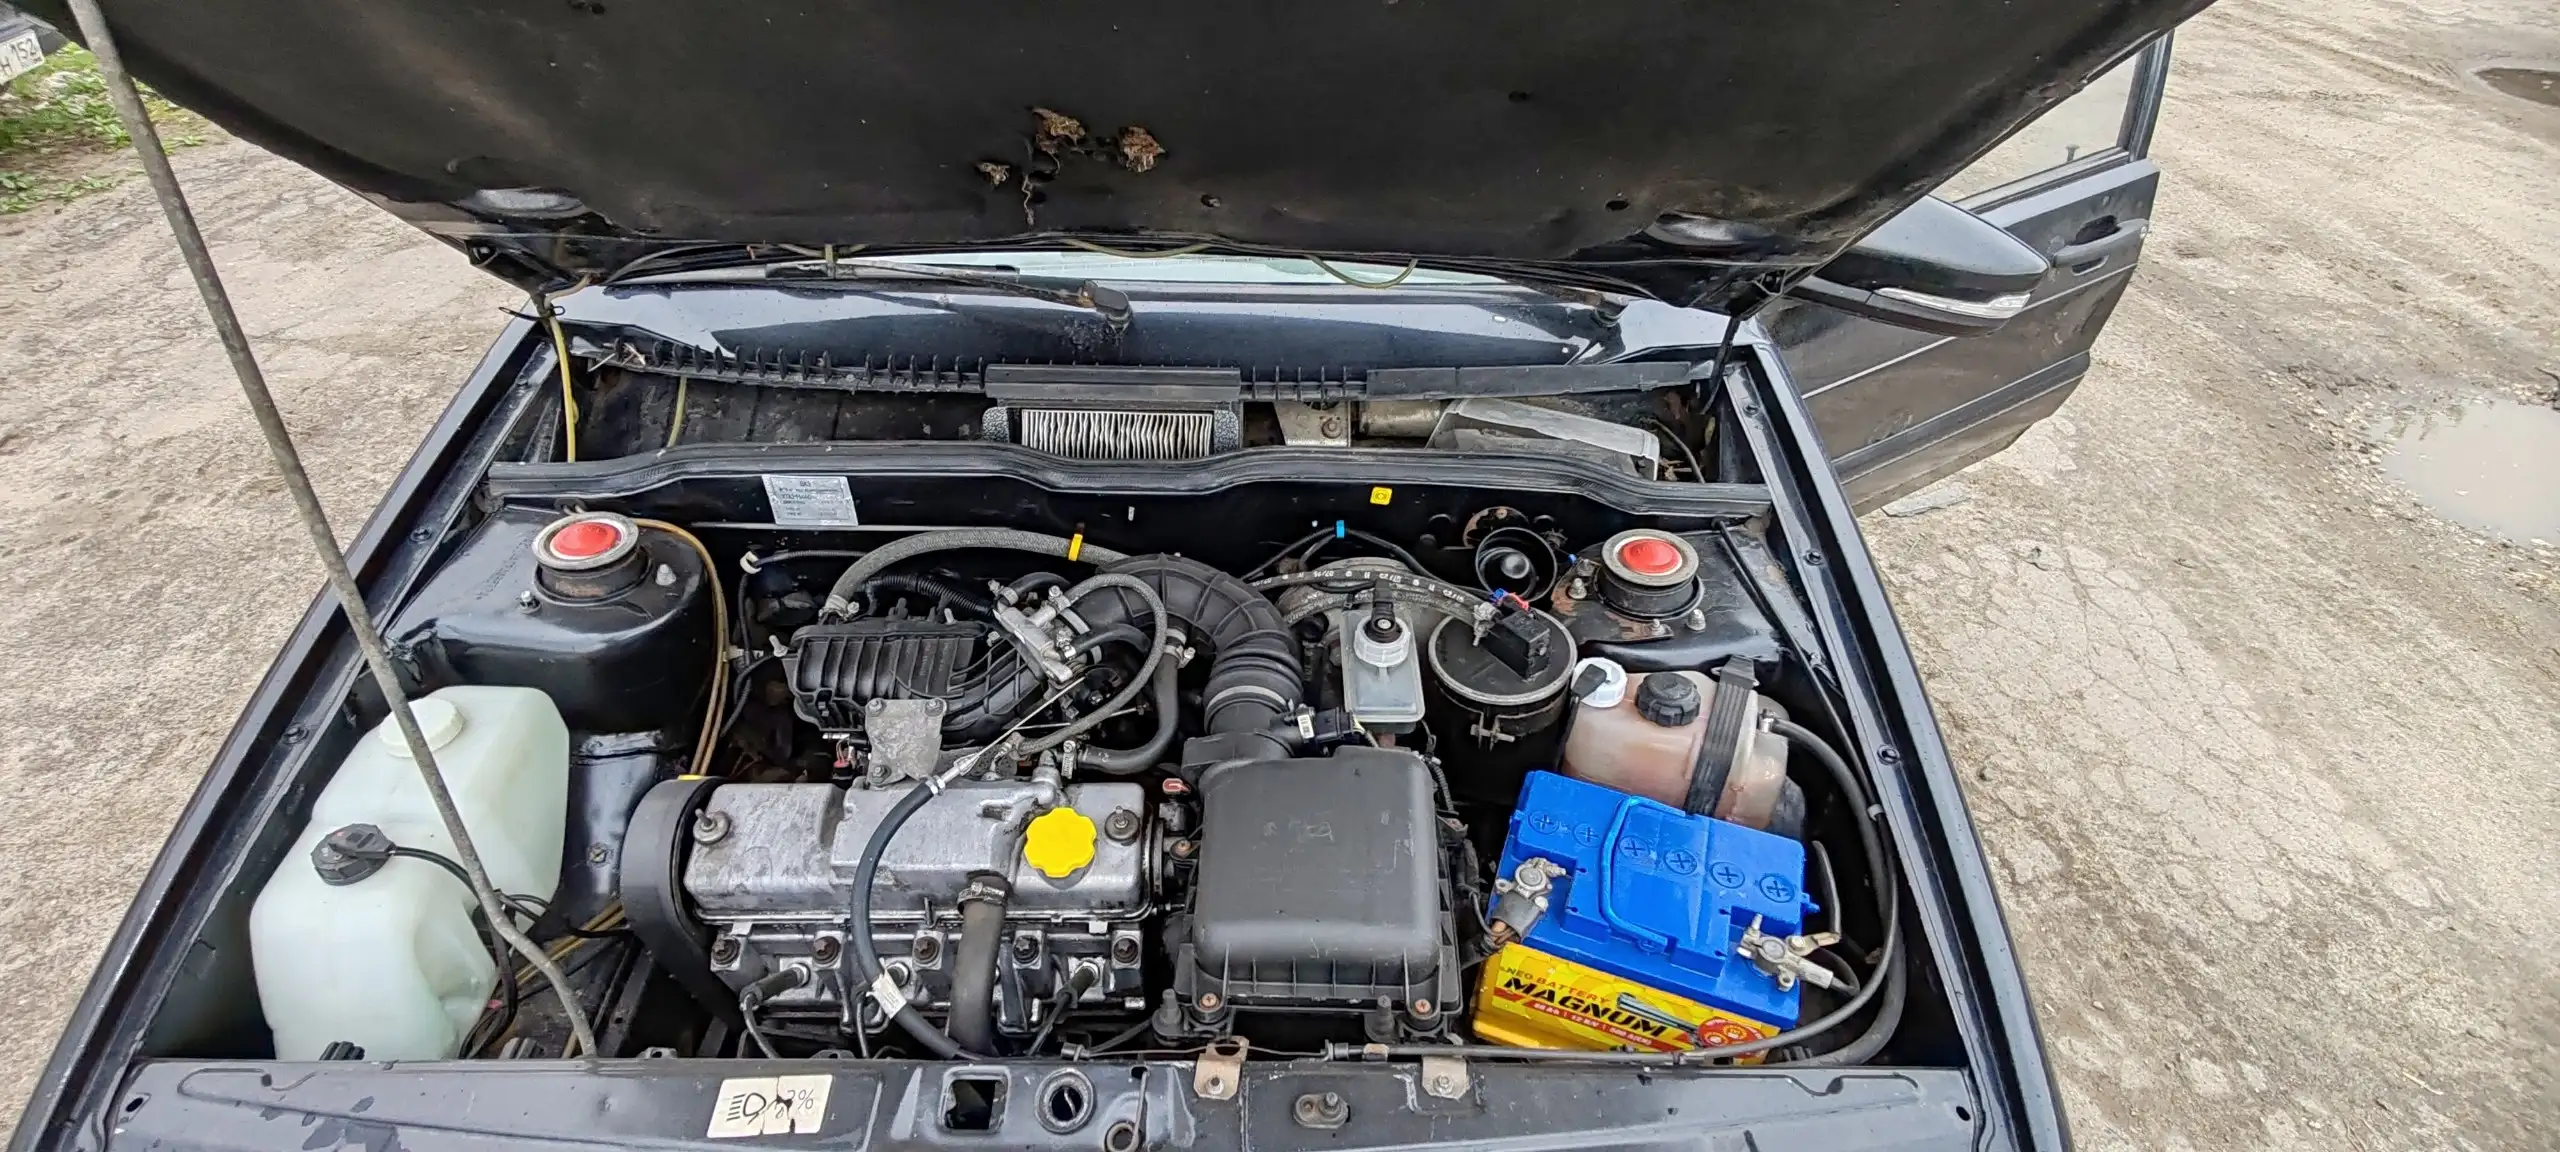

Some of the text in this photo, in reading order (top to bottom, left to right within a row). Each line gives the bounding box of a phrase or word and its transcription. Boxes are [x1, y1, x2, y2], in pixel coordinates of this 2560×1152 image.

[1504, 977, 1669, 1037] MAGNUM
[1507, 967, 1610, 1004] NEO BATTERY
